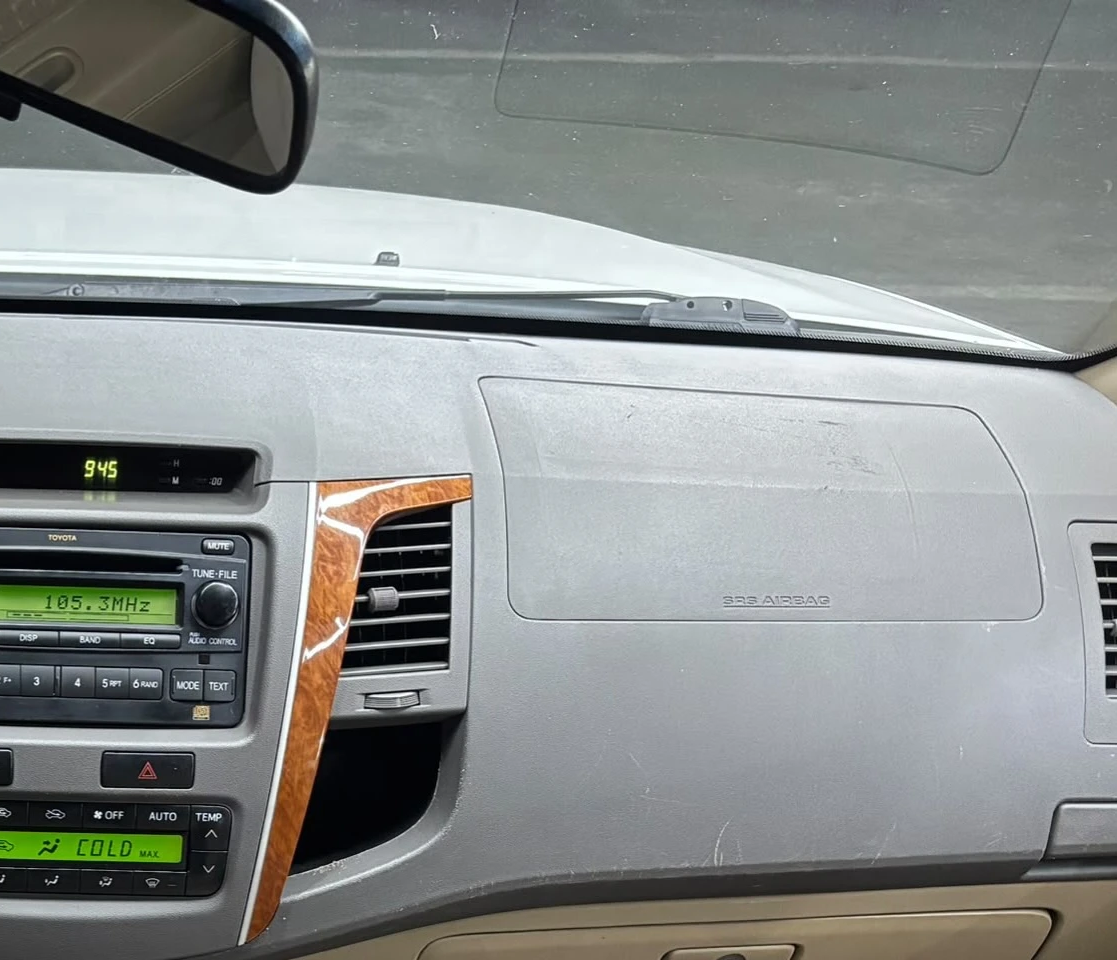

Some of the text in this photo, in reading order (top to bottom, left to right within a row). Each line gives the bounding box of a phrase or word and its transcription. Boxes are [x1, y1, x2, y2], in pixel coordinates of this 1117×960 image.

[172, 476, 180, 485] M
[48, 534, 77, 542] TOYOTA
[207, 542, 230, 550] MUTE
[45, 595, 151, 612] 105.3MHz
[723, 595, 831, 606] SRS AIRBAG
[19, 634, 39, 642] DISP
[79, 636, 101, 645] BAND
[143, 637, 156, 645] EQ
[188, 637, 238, 646] AUDIO CONTROL
[33, 677, 40, 686] 3
[74, 678, 81, 687] 4
[102, 679, 108, 688] 5
[133, 679, 140, 688] 6
[176, 681, 200, 690] MODE
[209, 682, 229, 691] TEXT
[105, 811, 124, 820] OFF
[148, 812, 177, 822] AUTO
[195, 812, 223, 822] TEMP
[76, 838, 133, 857] COLD
